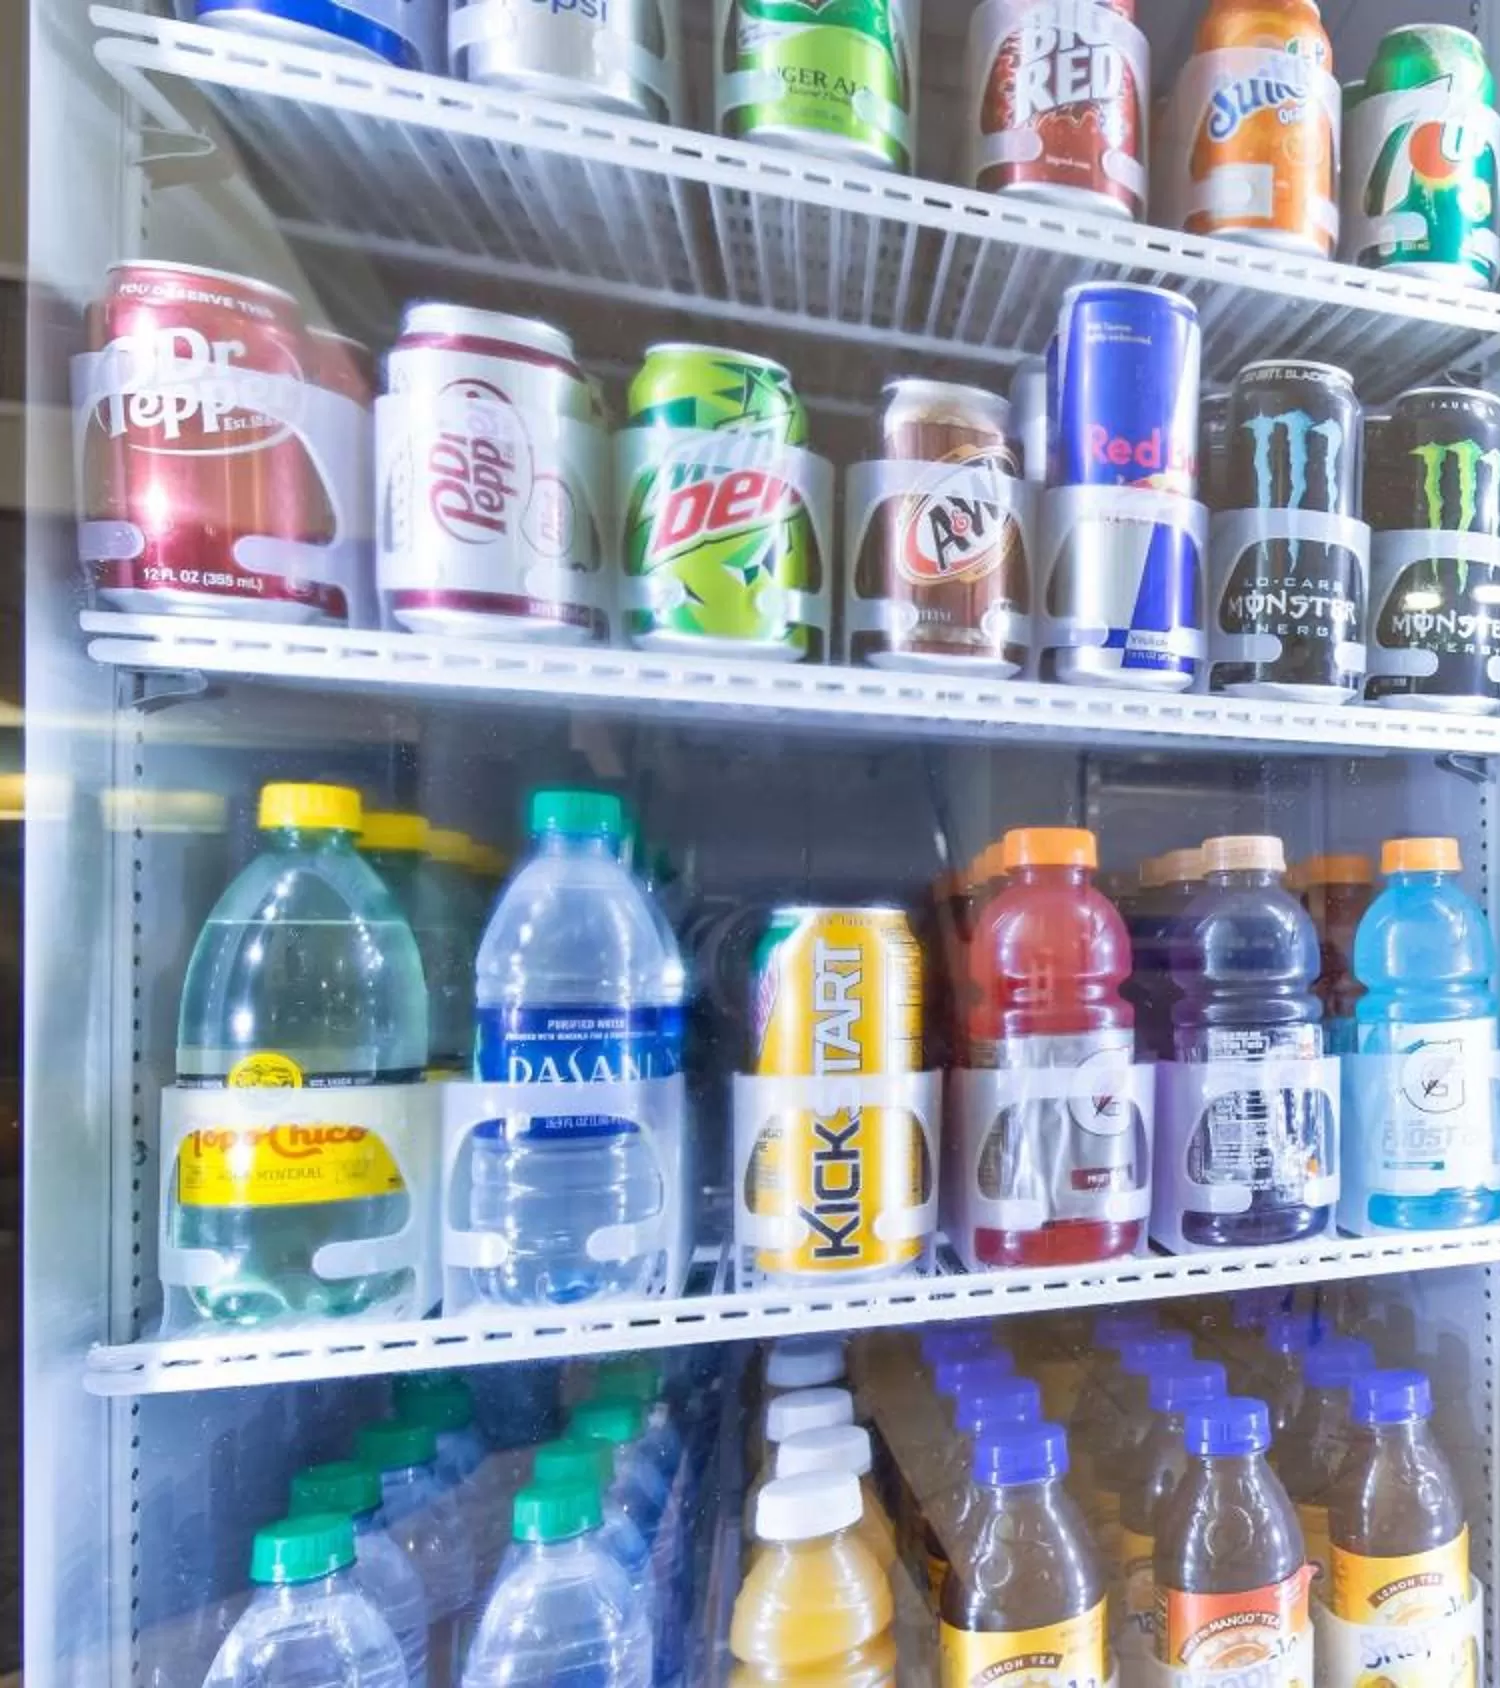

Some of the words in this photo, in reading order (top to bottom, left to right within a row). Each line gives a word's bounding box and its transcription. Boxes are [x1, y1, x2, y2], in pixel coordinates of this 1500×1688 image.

[1018, 0, 1112, 63] BIG
[1014, 46, 1124, 128] RED
[119, 283, 149, 297] YOU
[151, 284, 233, 309] DESERVE
[158, 327, 247, 380] Dr
[1087, 422, 1162, 469] Red
[143, 567, 159, 581] 12
[160, 568, 178, 582] FL
[180, 569, 200, 583] OZ
[1230, 590, 1357, 626] MONSTER
[507, 1046, 653, 1085] DASANI
[260, 1124, 369, 1159] Chico
